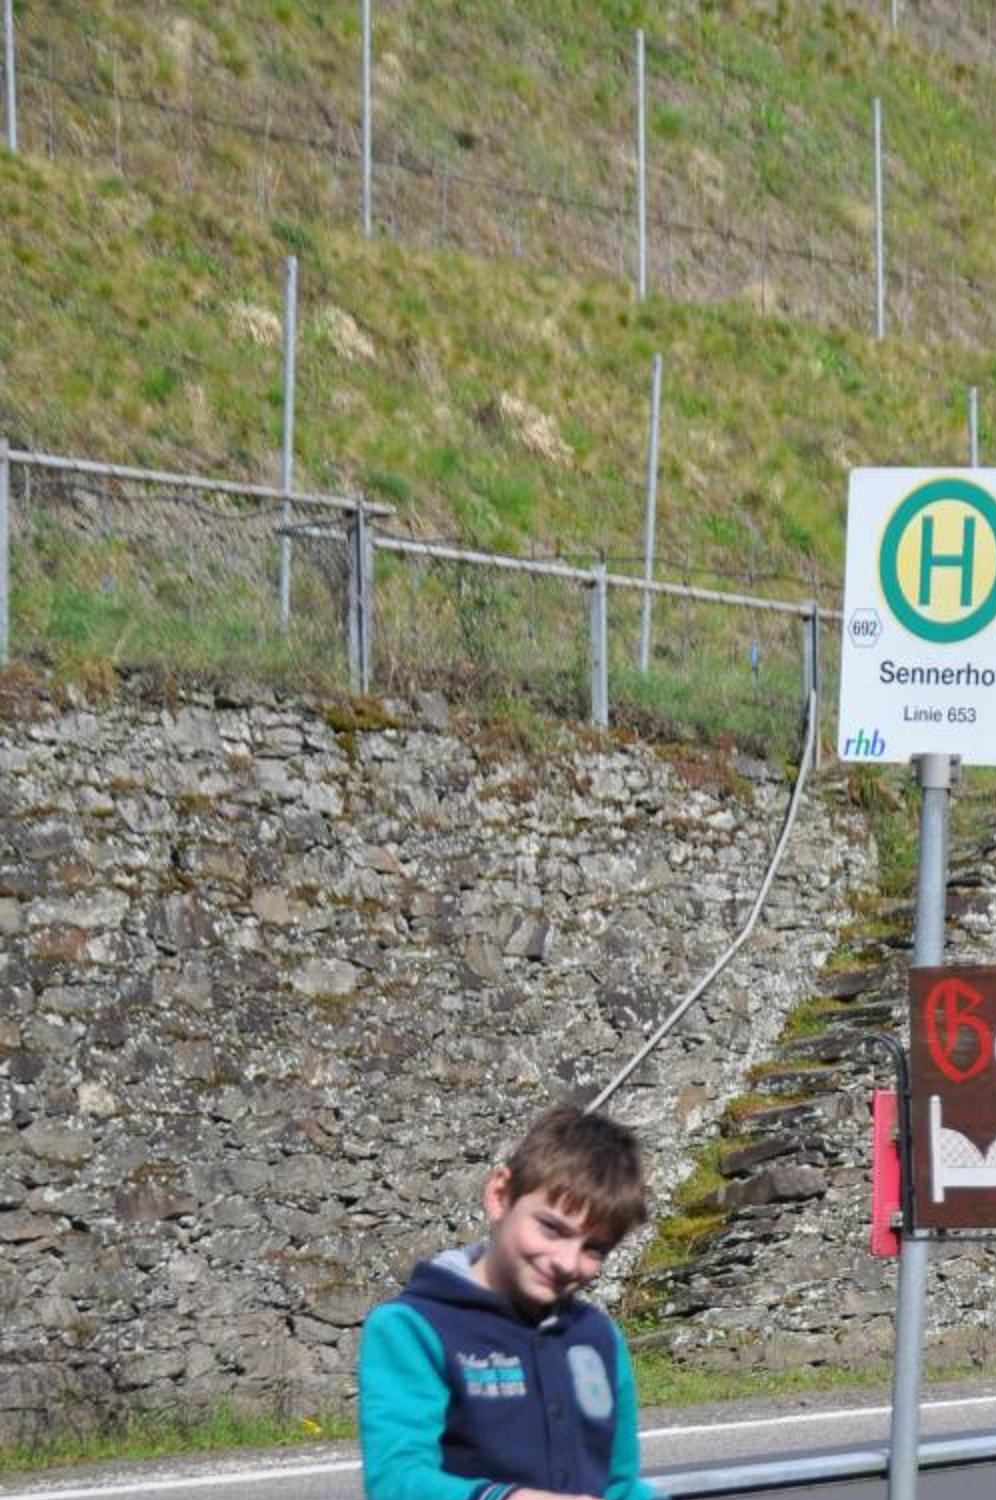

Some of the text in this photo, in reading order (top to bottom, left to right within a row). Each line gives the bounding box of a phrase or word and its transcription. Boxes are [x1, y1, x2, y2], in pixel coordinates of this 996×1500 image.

[918, 515, 976, 606] H
[853, 620, 877, 636] 692
[903, 706, 977, 723] Linie 653
[843, 729, 886, 757] rhb
